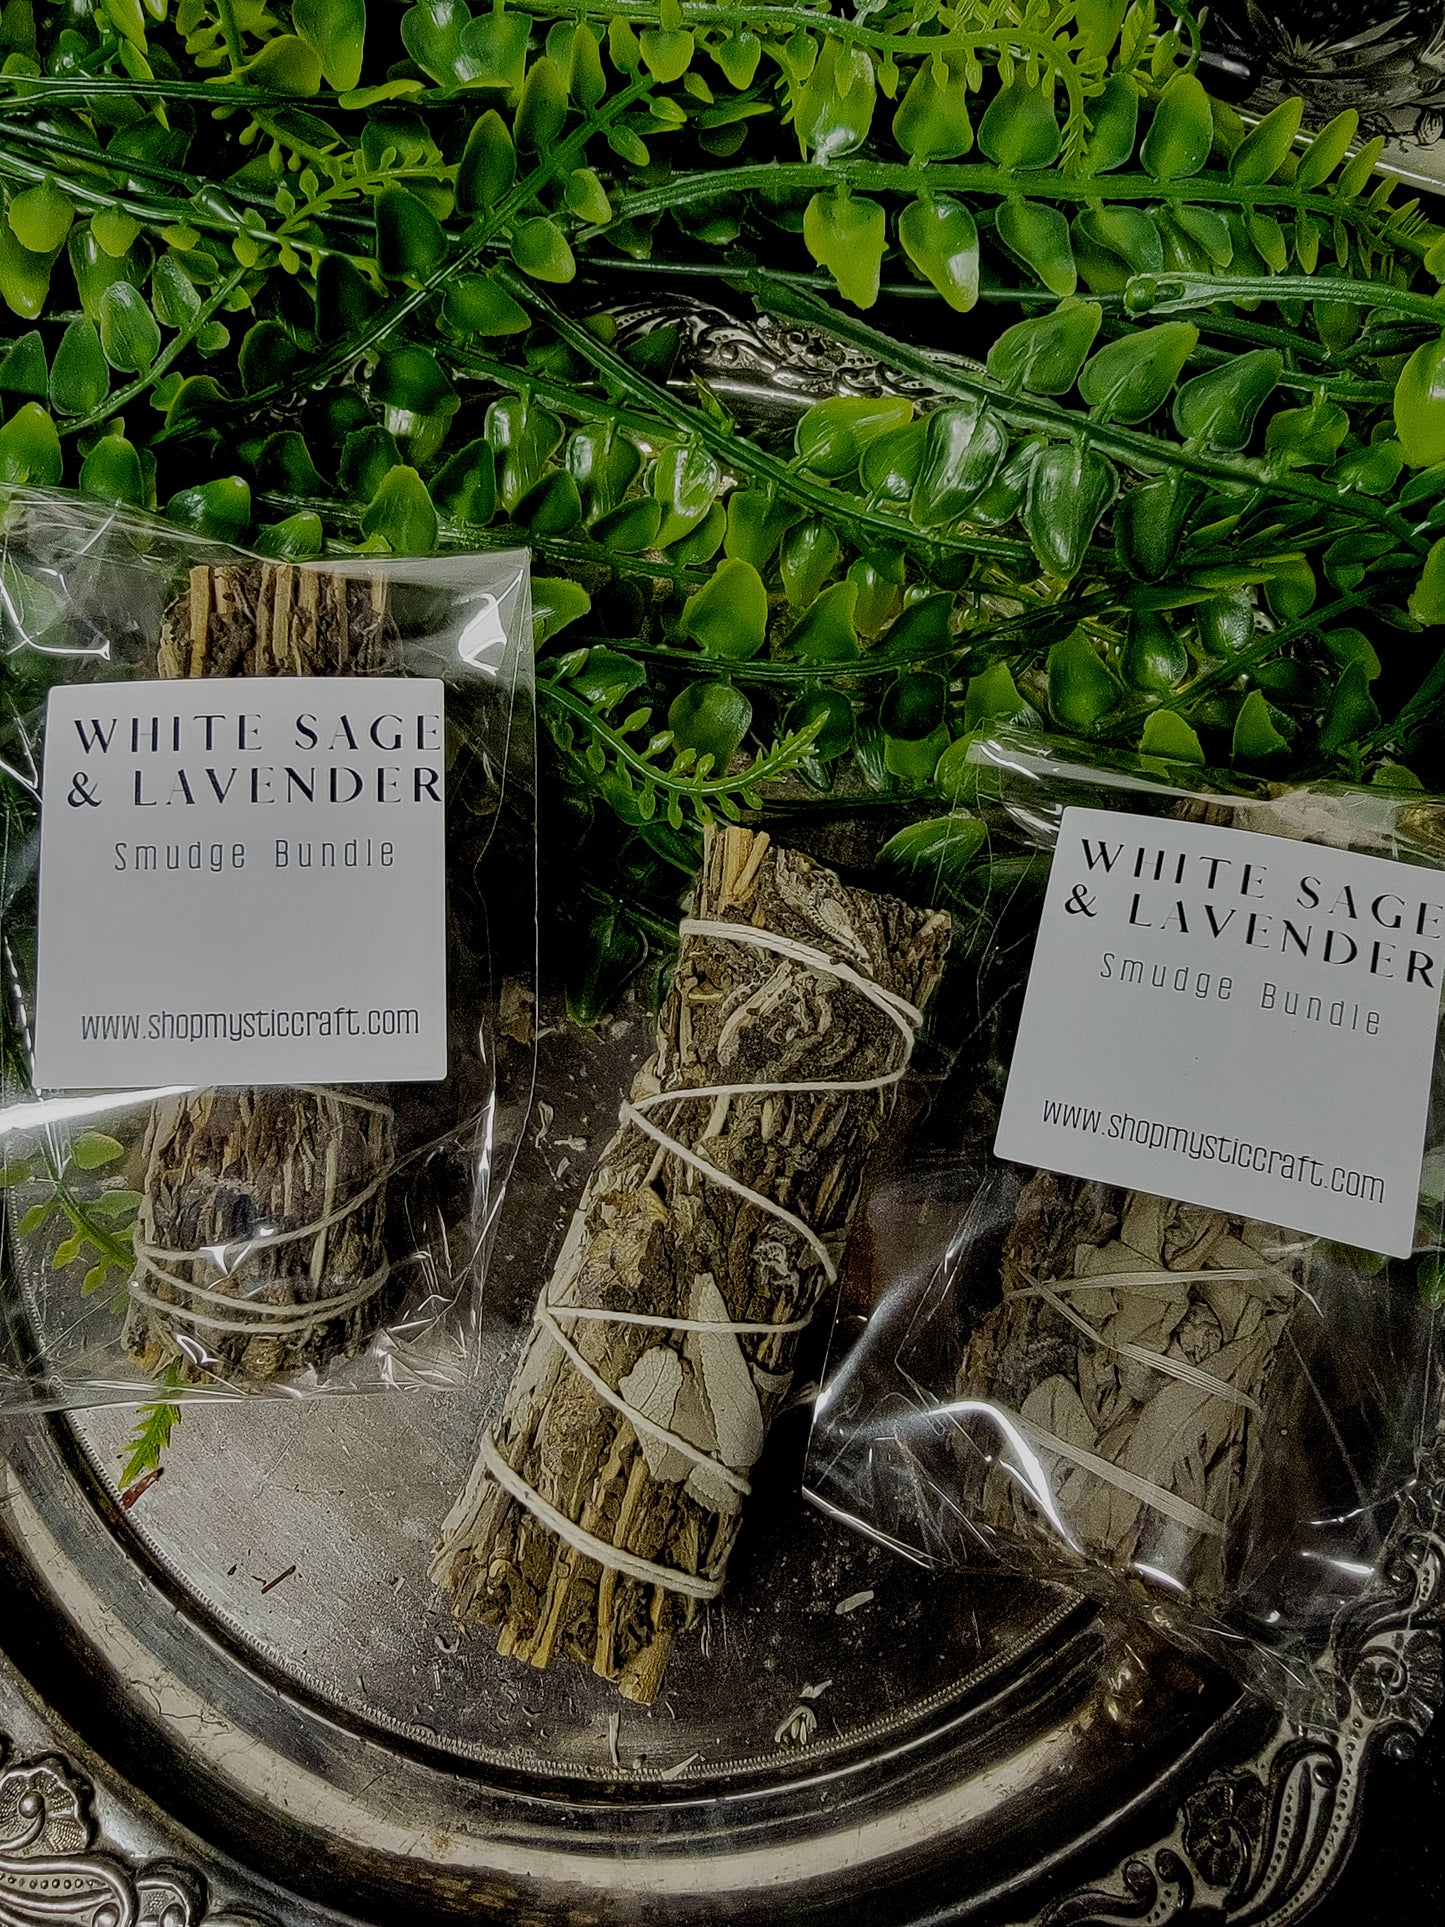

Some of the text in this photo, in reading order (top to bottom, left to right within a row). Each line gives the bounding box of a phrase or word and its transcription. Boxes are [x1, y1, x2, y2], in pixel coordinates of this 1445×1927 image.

[73, 713, 442, 755] WHITE SAGE
[66, 766, 442, 808] & LAVENDER
[114, 838, 395, 873] Smudge Bundle
[1080, 838, 1444, 939] WHITE SAGE
[1064, 883, 1436, 989] & LAVENDER
[81, 1006, 420, 1043] www.shopmysticcraft.com
[1099, 952, 1381, 1036] Smudge Bundle
[1042, 1099, 1386, 1204] www.shopmysticcraft.com
